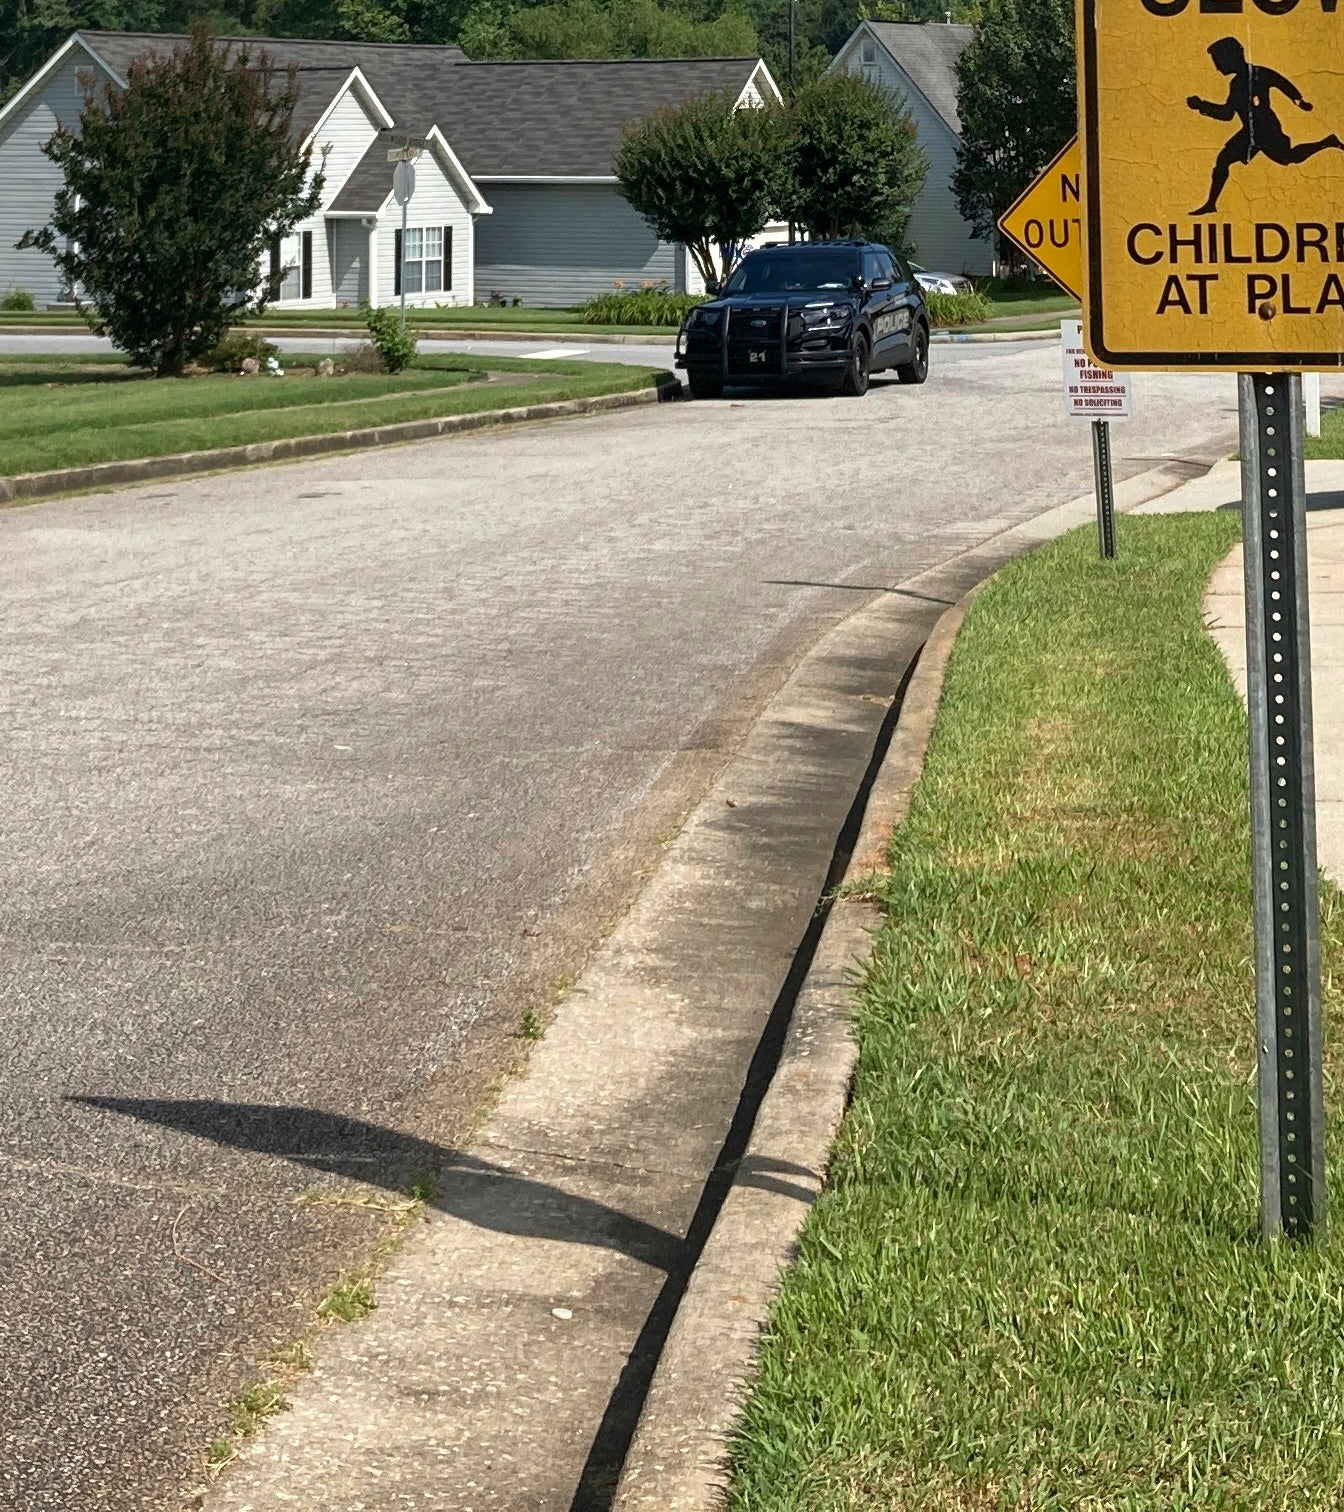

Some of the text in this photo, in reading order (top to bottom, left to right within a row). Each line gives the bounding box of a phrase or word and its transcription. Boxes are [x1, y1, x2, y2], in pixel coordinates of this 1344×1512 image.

[1060, 173, 1080, 203] N
[1156, 273, 1219, 315] AT
[875, 311, 910, 336] POLICE
[749, 352, 766, 363] 21
[1074, 358, 1086, 368] NO
[1079, 369, 1114, 380] FISHING
[1068, 385, 1126, 394] NO TRESPASSING
[1073, 398, 1123, 407] NO SOLICITING
